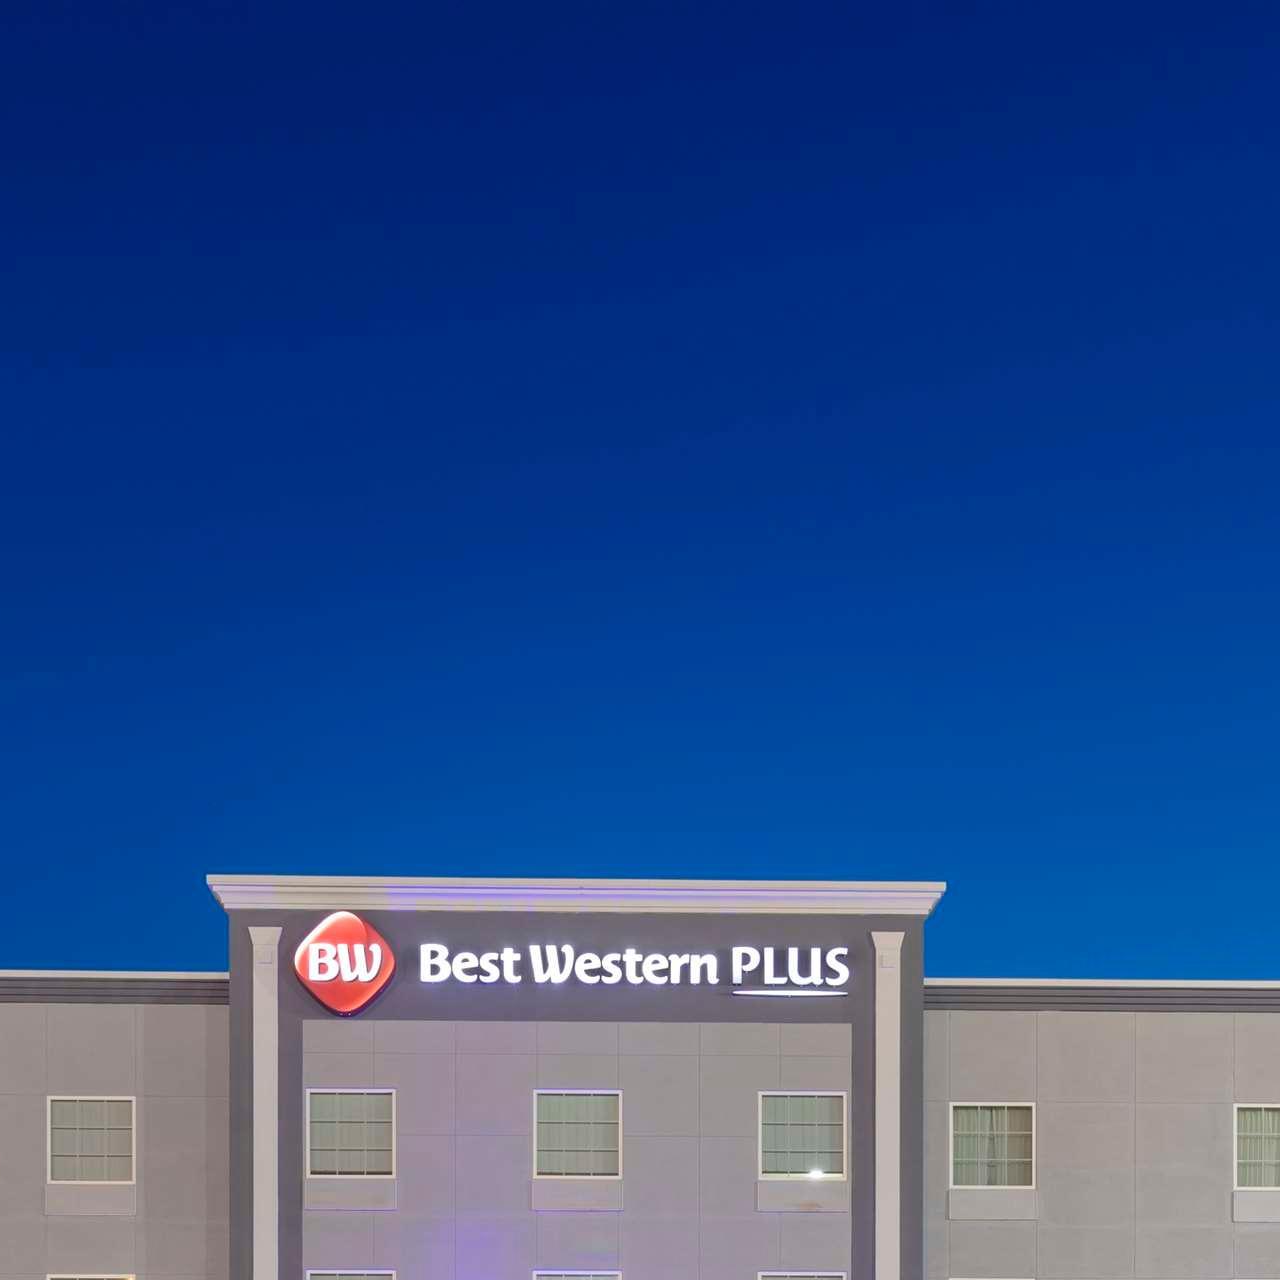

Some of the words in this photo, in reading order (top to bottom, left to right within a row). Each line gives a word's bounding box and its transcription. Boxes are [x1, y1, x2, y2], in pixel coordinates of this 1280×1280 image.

[307, 943, 382, 983] BW
[420, 943, 522, 984] Best
[528, 943, 720, 985] Western
[732, 946, 851, 987] PLUS
